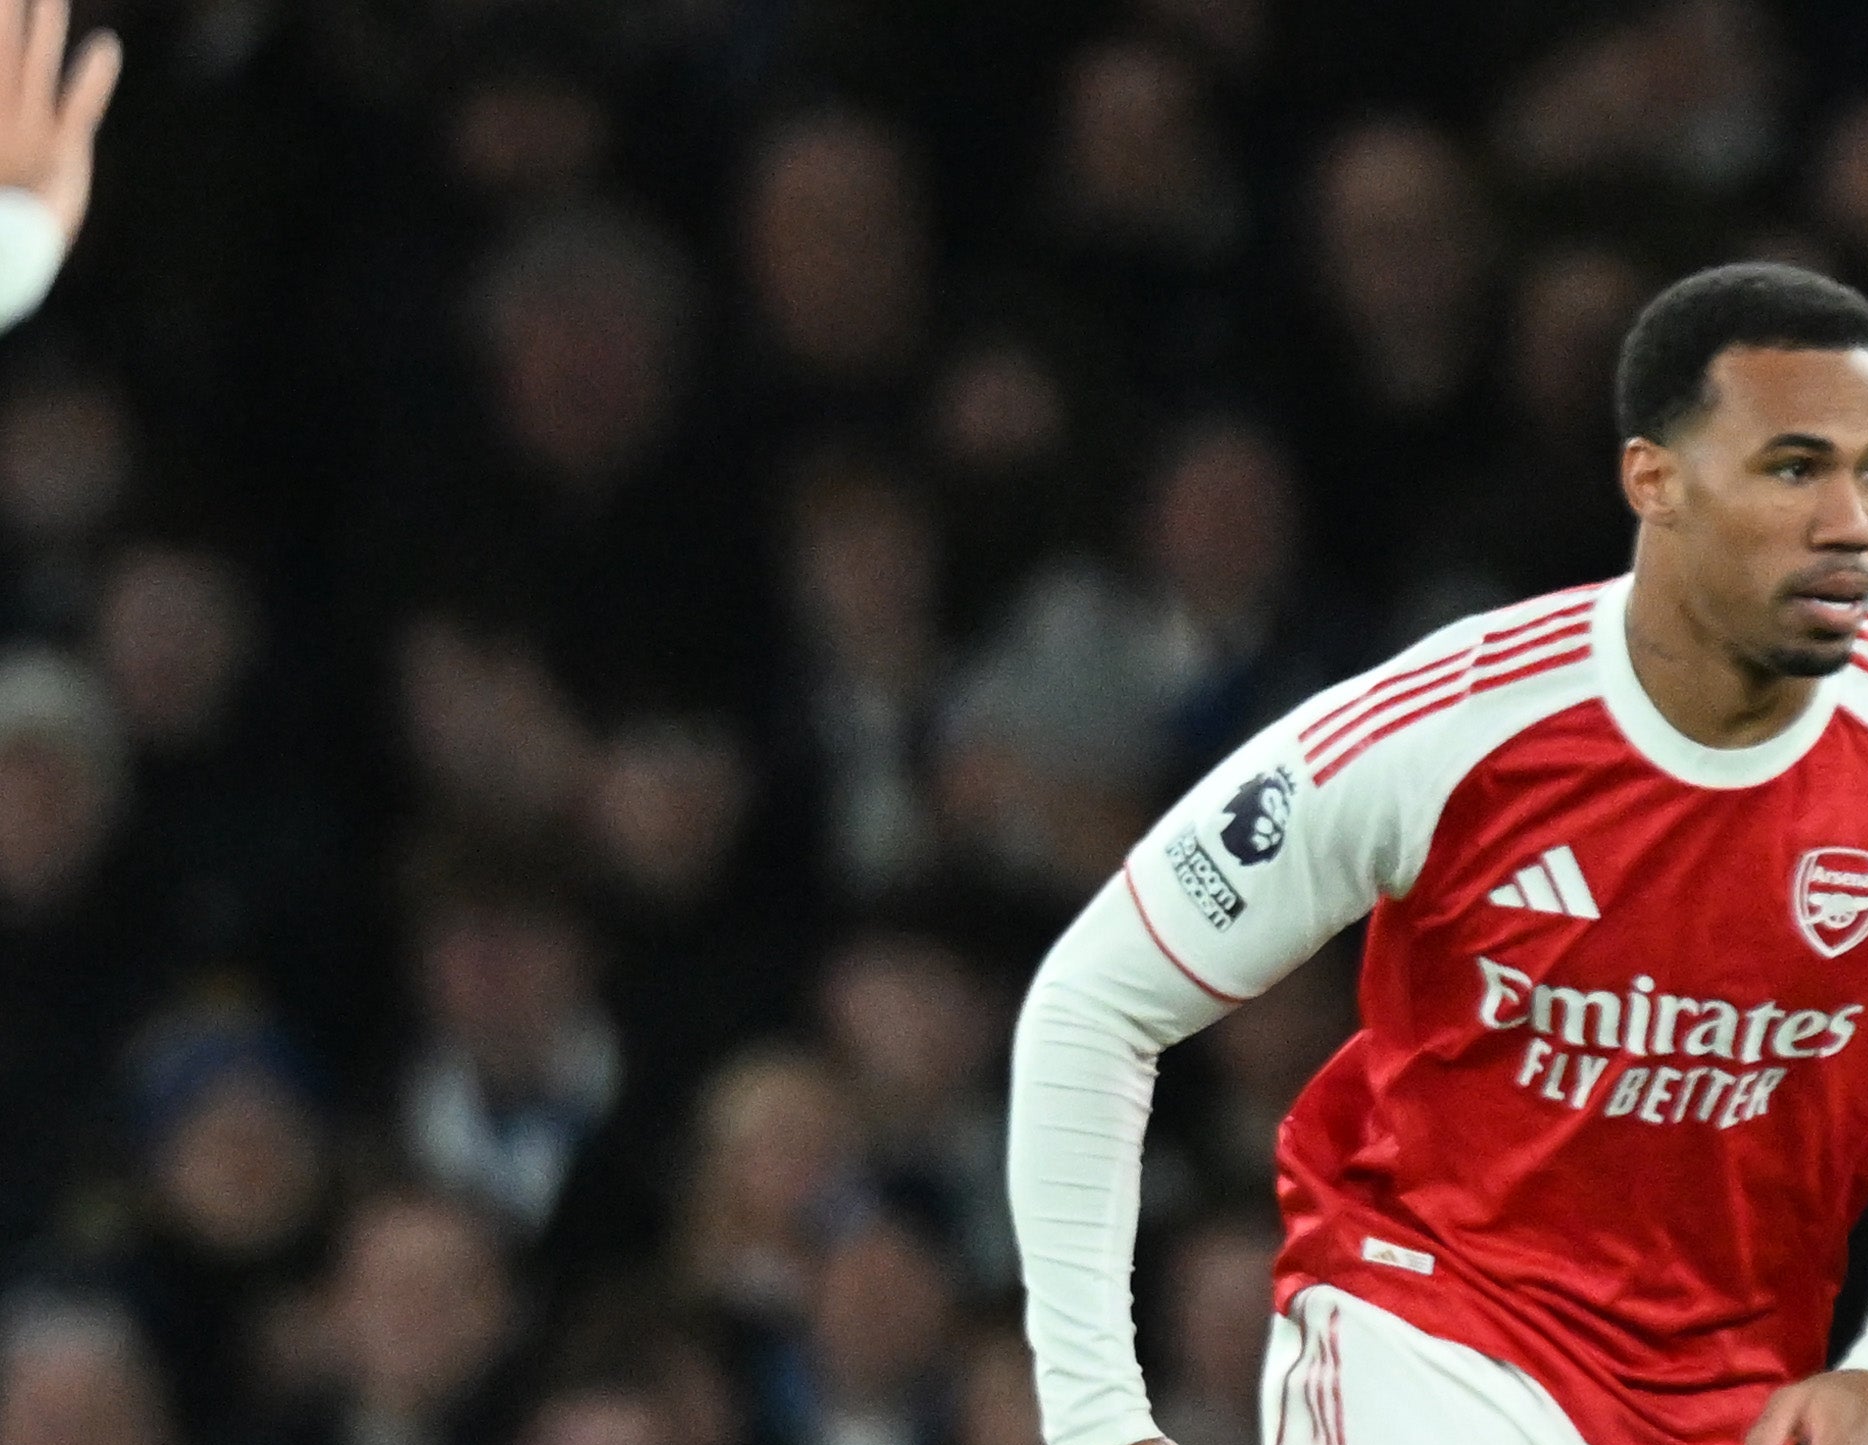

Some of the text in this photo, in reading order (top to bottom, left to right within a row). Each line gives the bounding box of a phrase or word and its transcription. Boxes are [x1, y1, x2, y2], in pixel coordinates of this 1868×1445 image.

[1477, 956, 1864, 1064] Emirates
[1519, 1038, 1788, 1131] FLY BETTER
